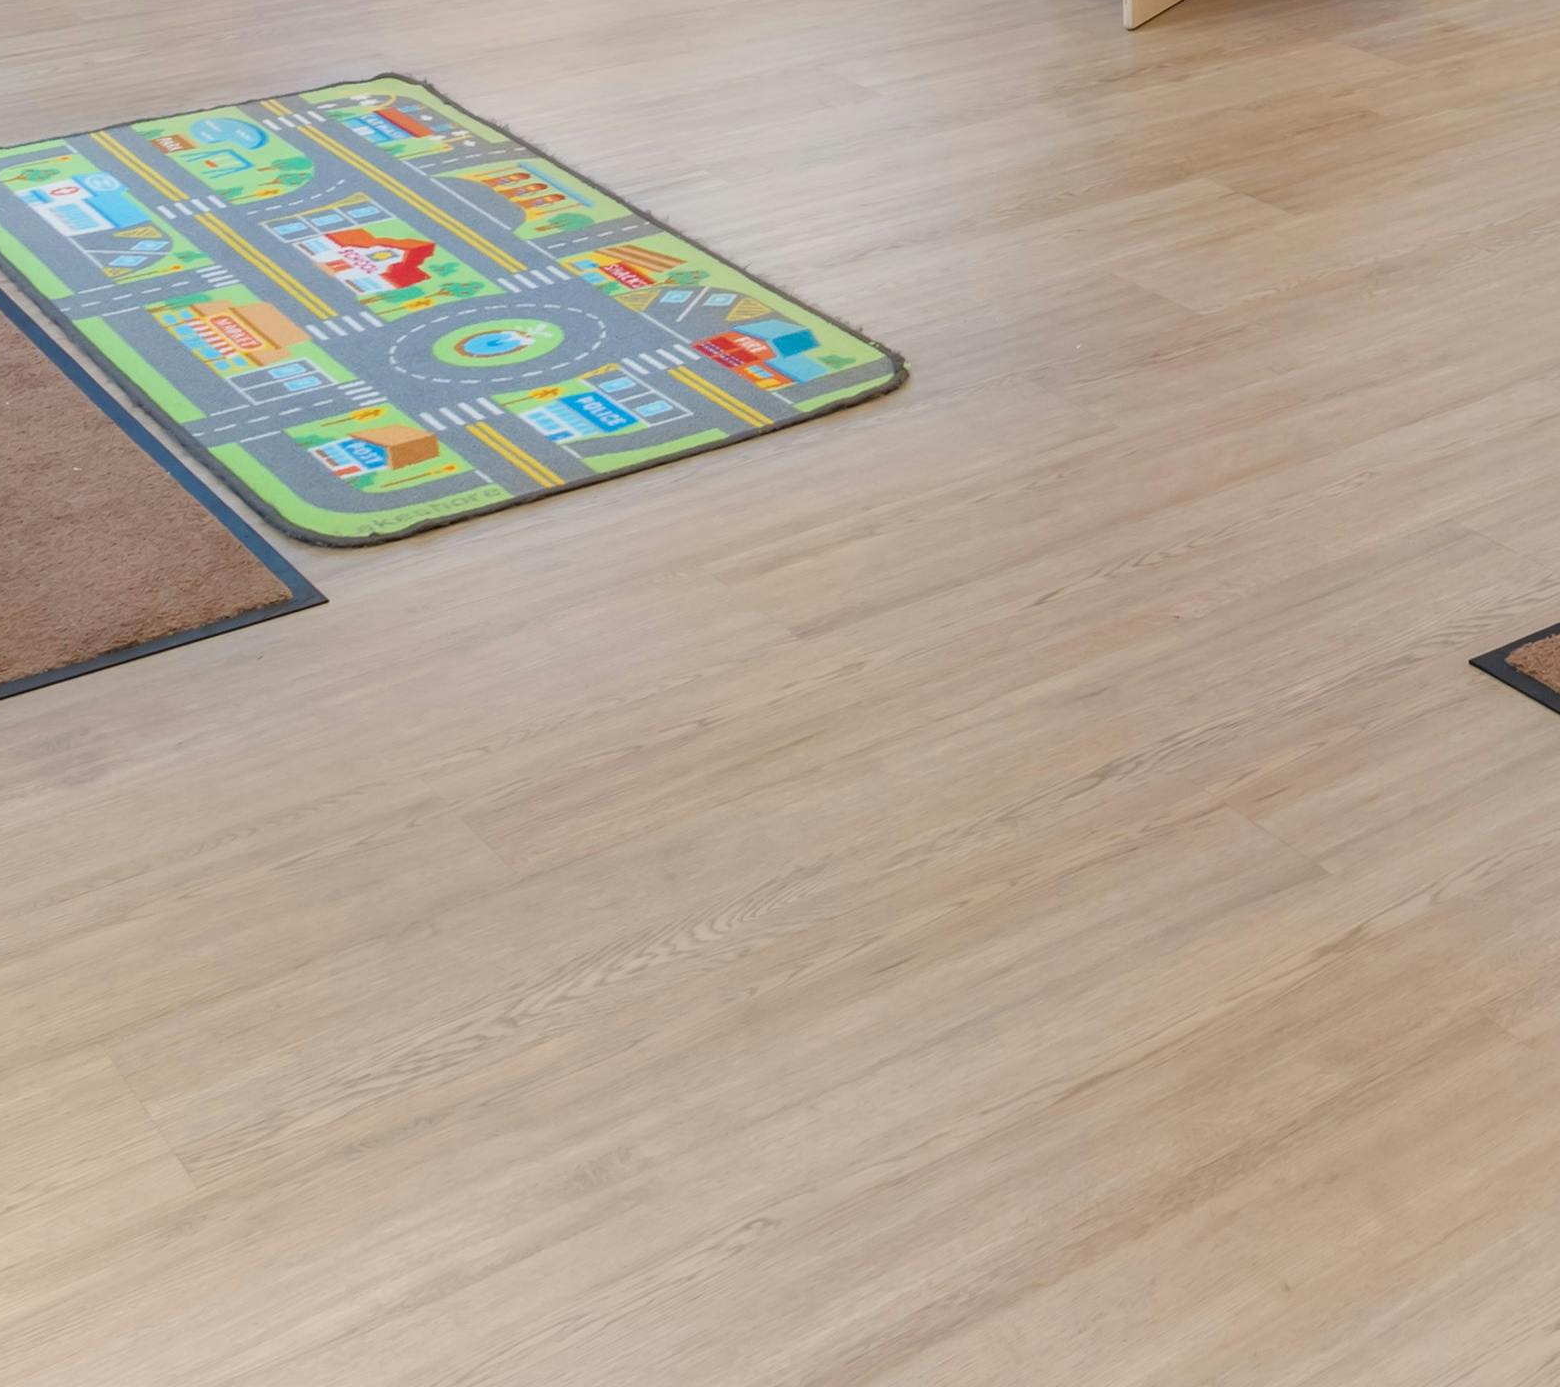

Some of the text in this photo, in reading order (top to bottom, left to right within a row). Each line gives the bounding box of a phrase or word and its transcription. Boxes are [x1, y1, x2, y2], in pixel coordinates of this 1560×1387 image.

[340, 247, 379, 274] SCHOOL
[577, 394, 628, 428] POLICE
[348, 440, 379, 466] POST
[355, 487, 502, 533] akeshore
